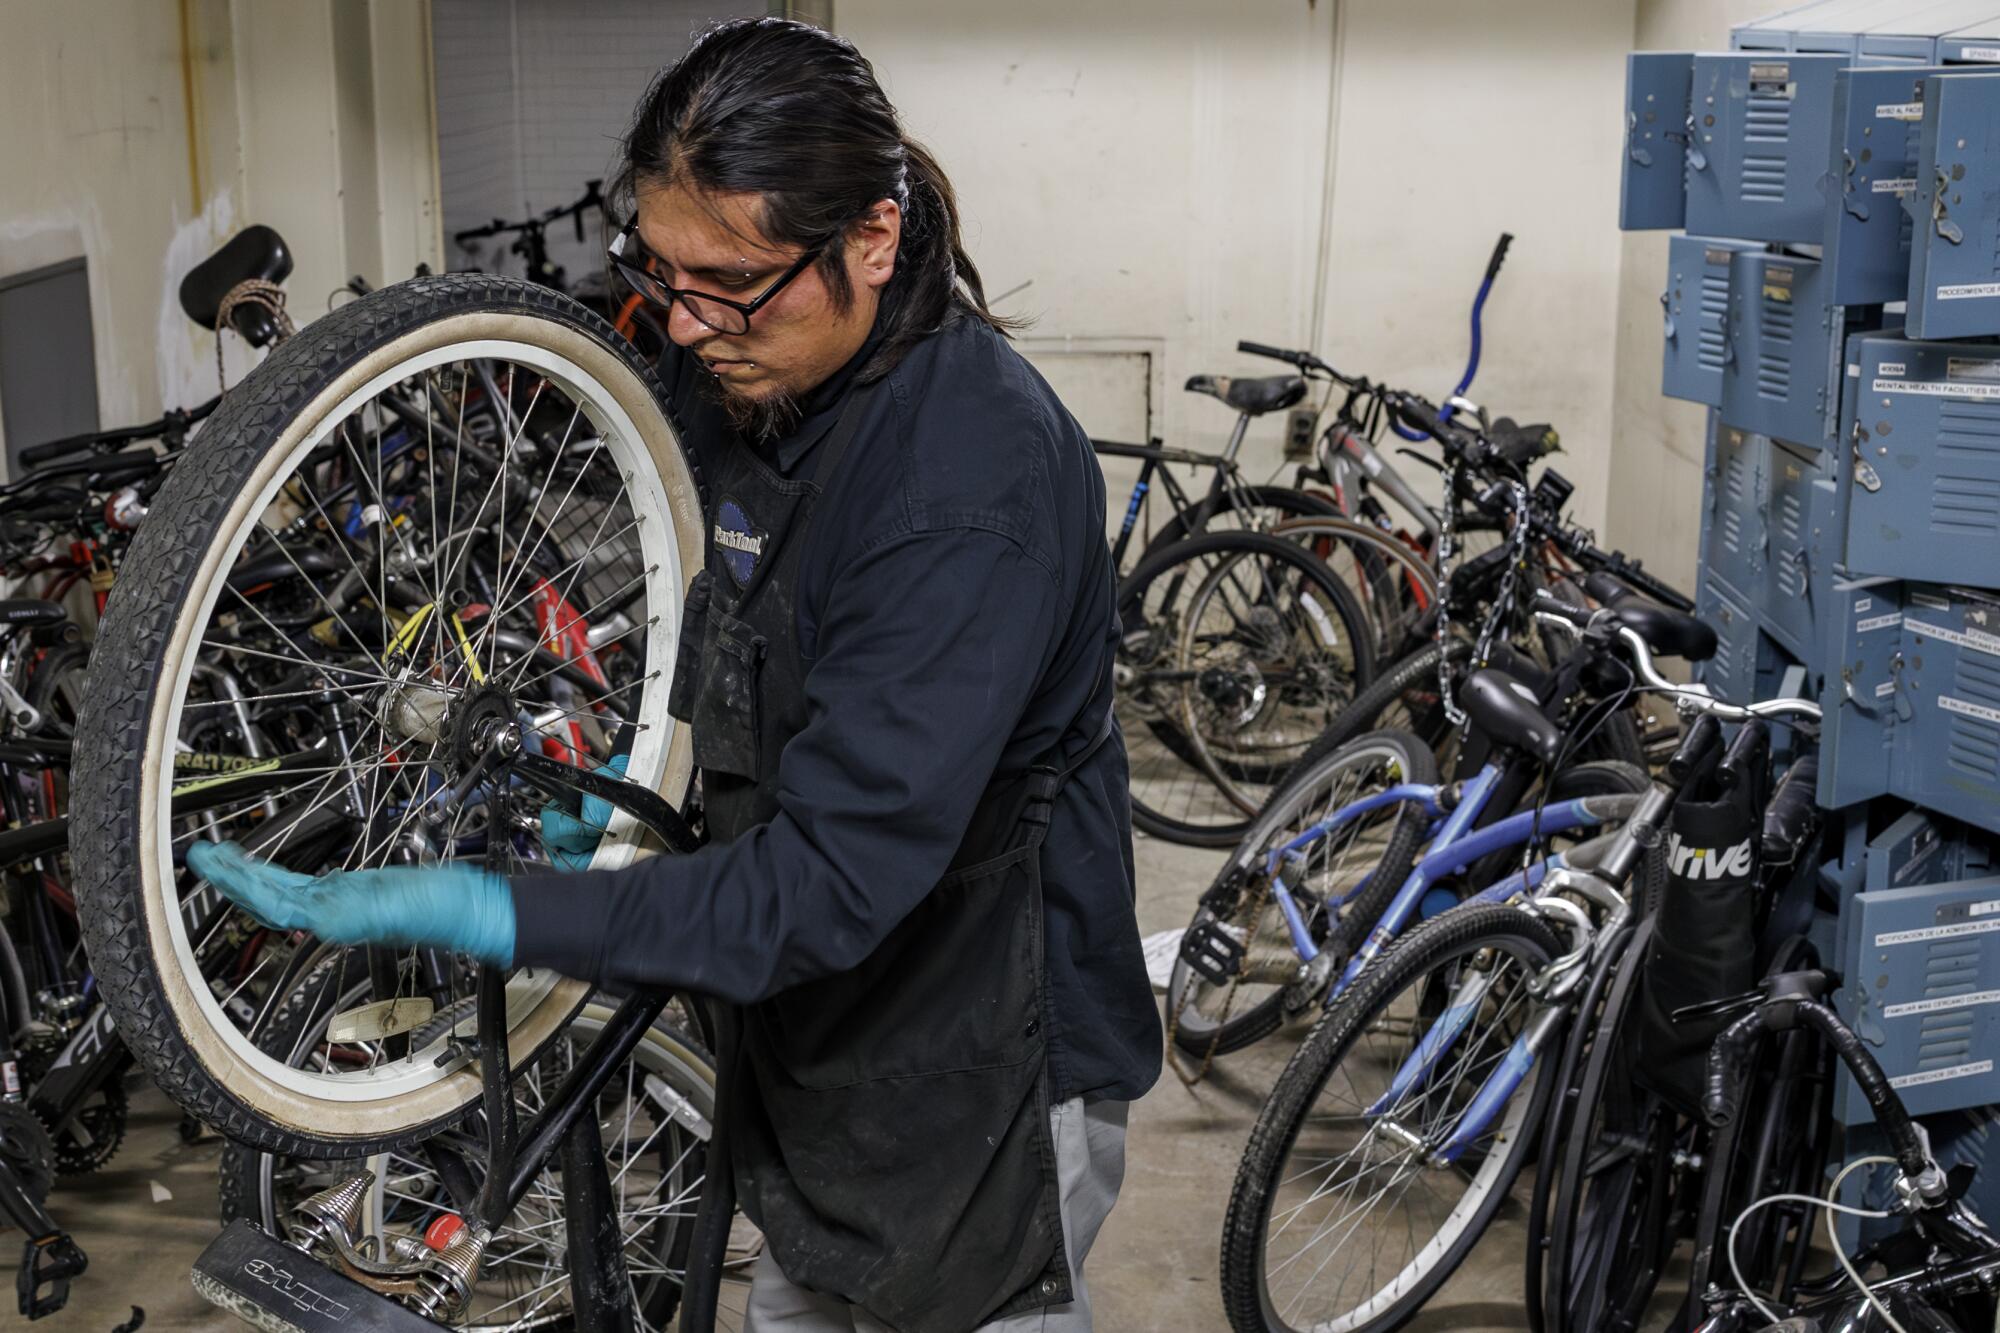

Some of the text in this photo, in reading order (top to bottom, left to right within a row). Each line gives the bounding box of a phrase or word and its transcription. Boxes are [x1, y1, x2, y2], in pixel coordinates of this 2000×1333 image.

[1875, 382, 1906, 390] MENTAL
[1909, 383, 1941, 392] HEALTH
[1943, 384, 1987, 395] FACILITIES
[1666, 832, 1752, 881] drive
